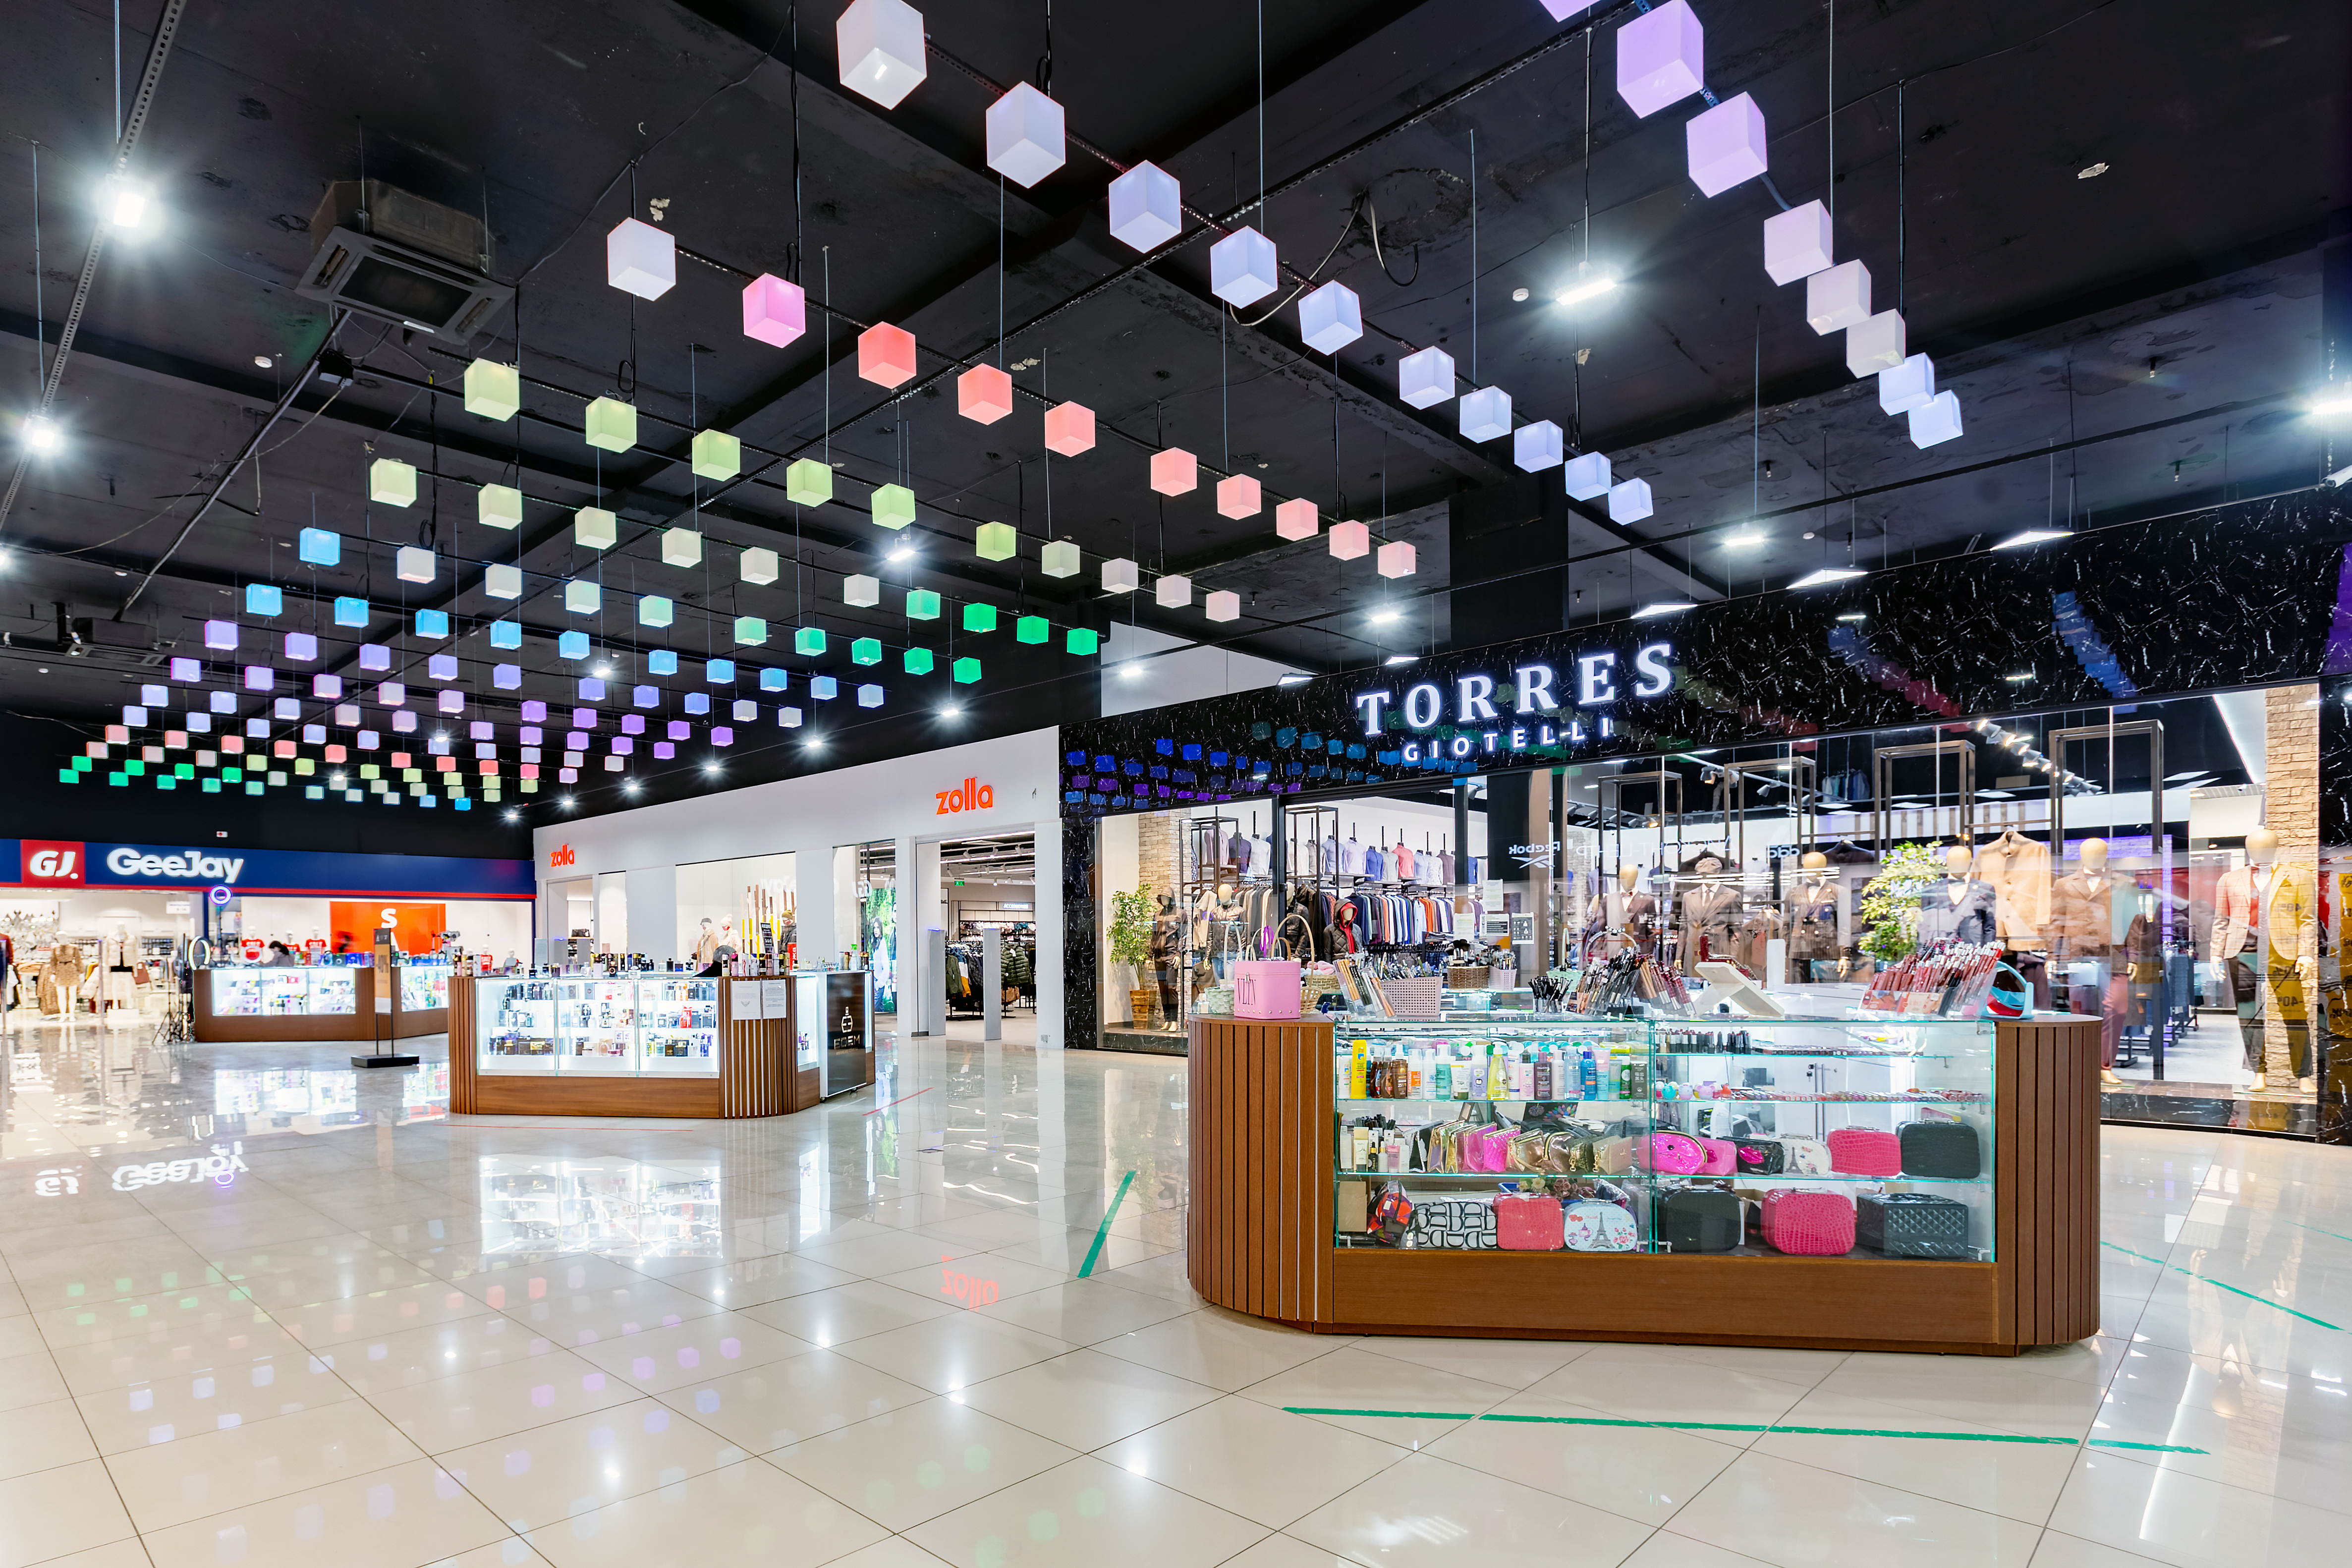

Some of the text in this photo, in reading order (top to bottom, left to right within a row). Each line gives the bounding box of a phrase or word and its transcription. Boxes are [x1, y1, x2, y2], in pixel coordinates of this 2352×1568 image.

[1357, 644, 1672, 736] TORRES
[1404, 717, 1610, 762] GIOTELLI
[936, 777, 994, 815] zolla
[107, 847, 244, 883] GeeJay
[550, 844, 575, 867] zolla
[834, 1034, 860, 1050] EDEM
